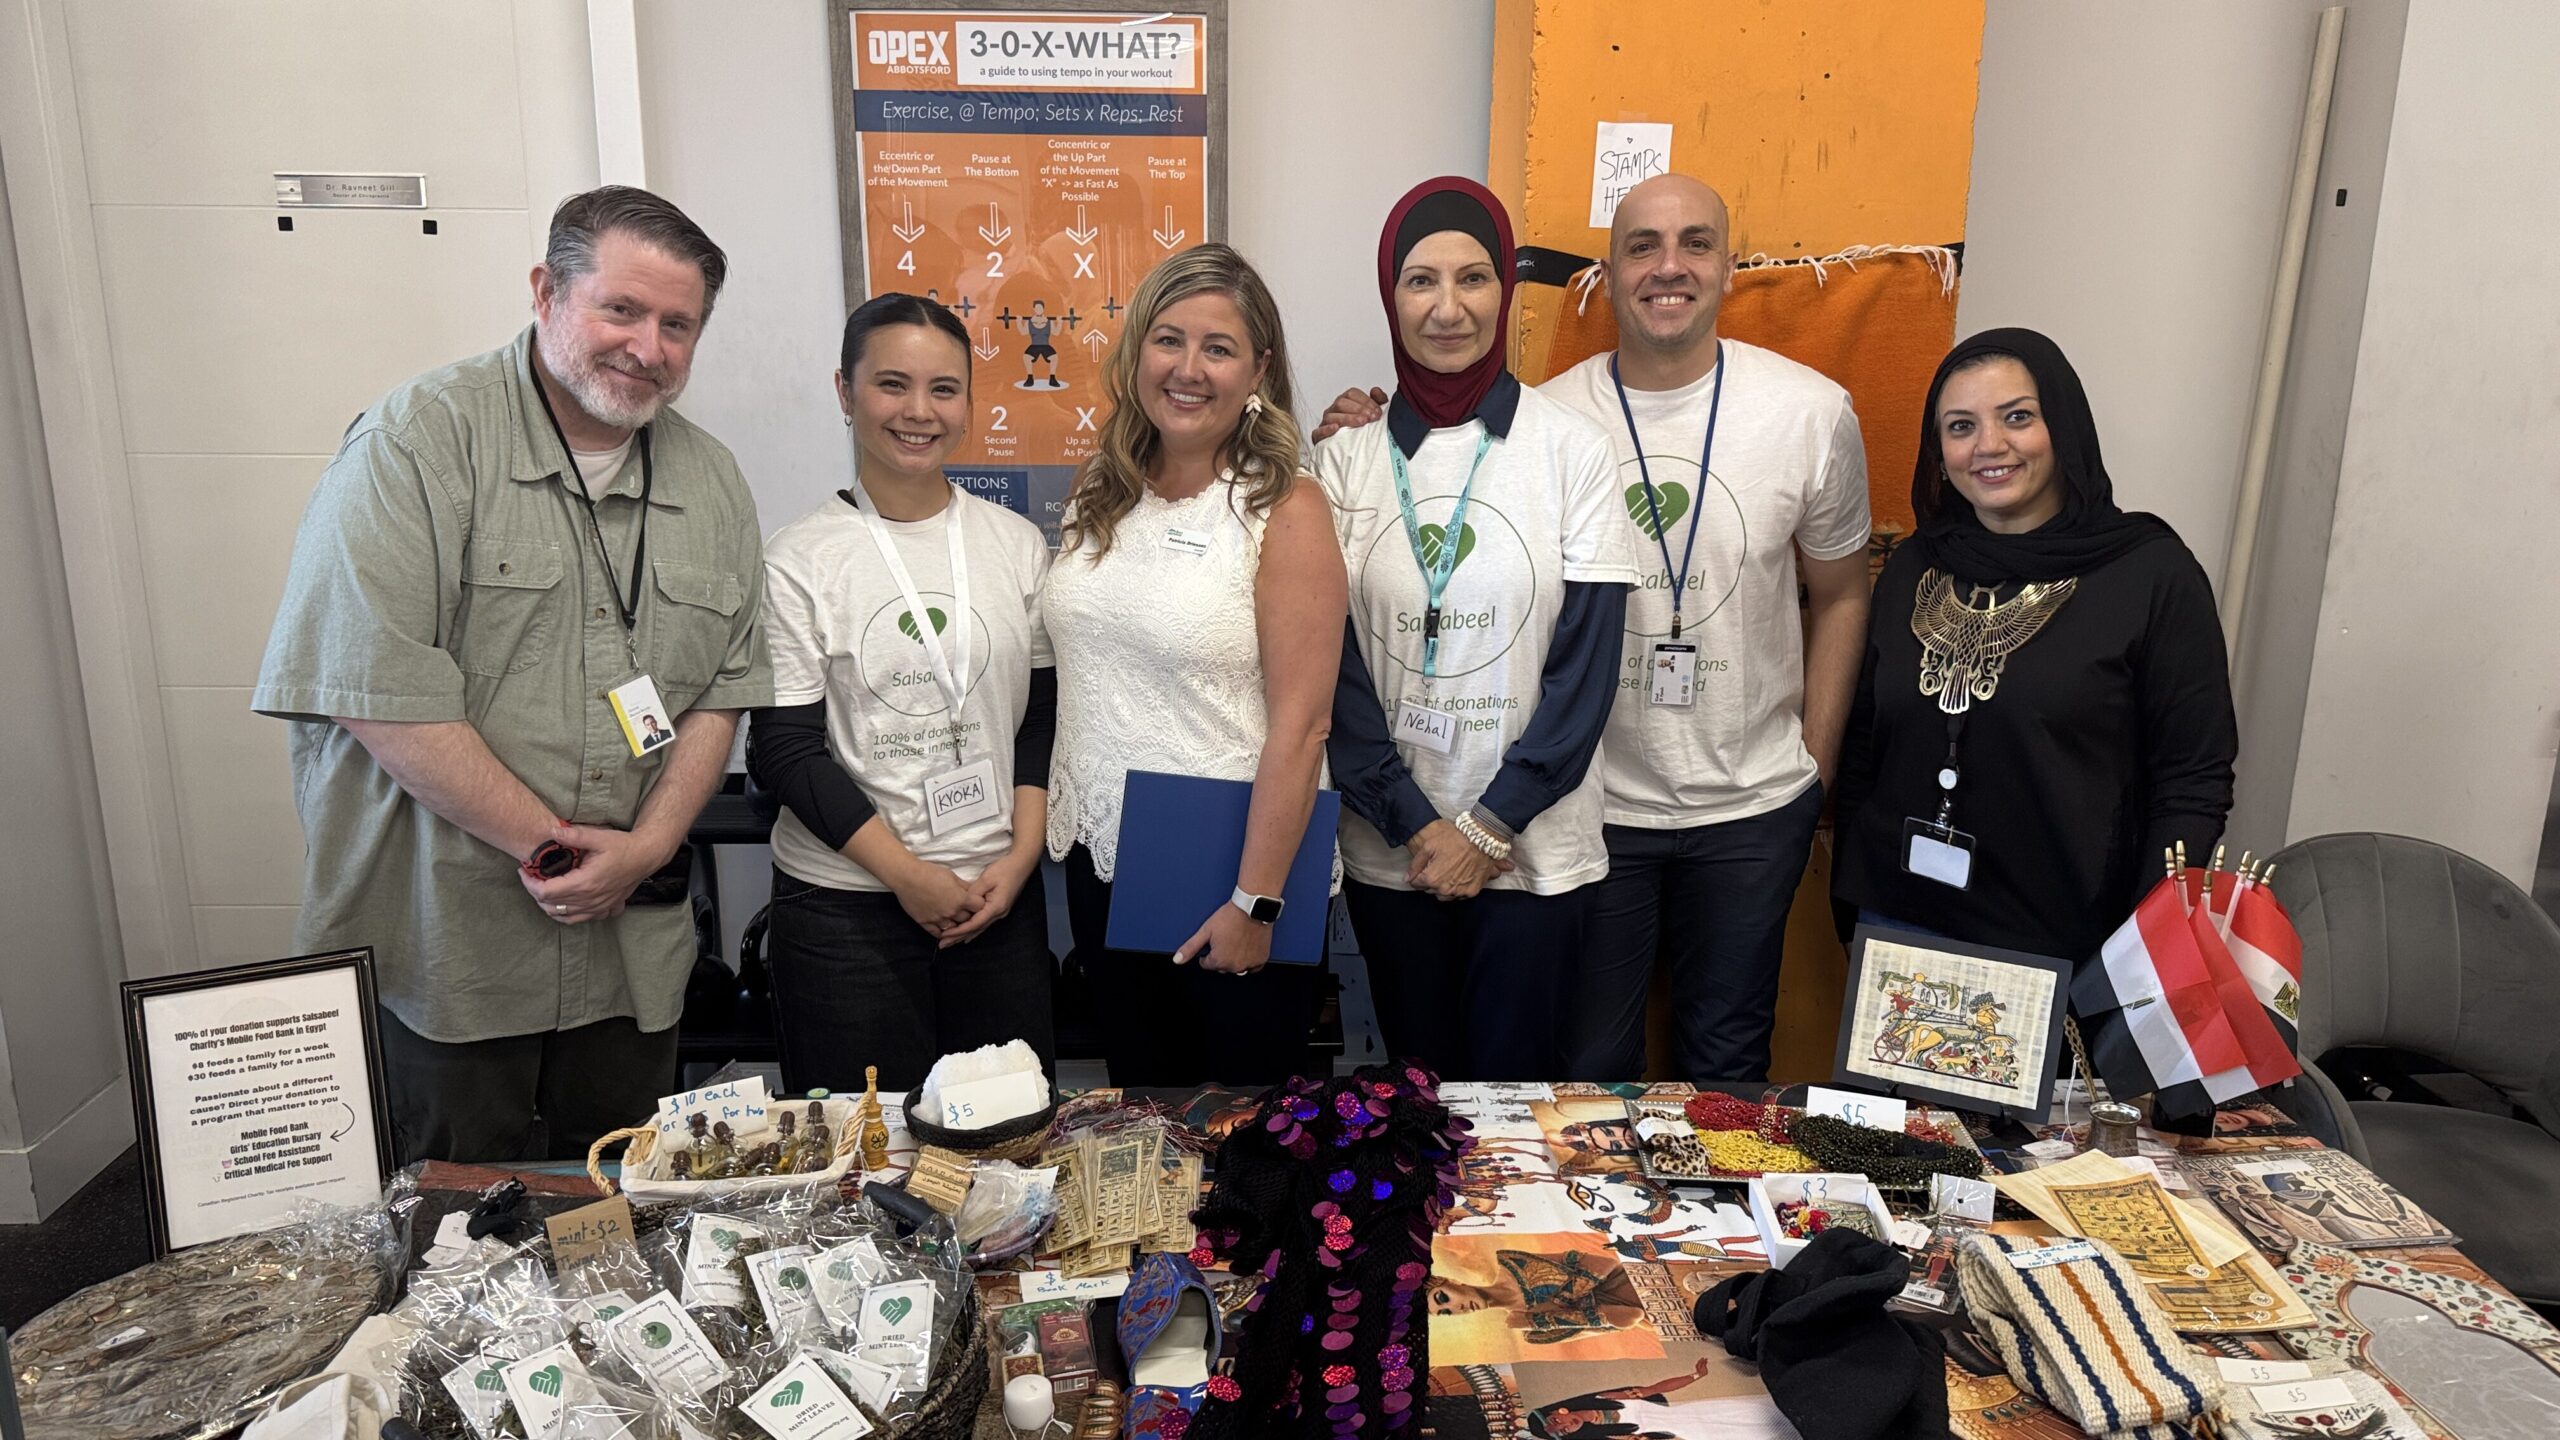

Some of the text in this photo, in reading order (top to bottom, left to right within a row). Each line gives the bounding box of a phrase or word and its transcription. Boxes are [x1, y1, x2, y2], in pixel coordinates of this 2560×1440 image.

[868, 30, 950, 65] OPEX
[970, 30, 1182, 60] 3-0-X-WHAT?
[887, 65, 951, 75] ABBOTSFORD
[988, 67, 1015, 78] guide
[1018, 68, 1029, 76] to
[1031, 67, 1057, 79] using
[1060, 68, 1092, 79] tempo
[1095, 67, 1104, 77] in
[1106, 69, 1128, 80] your
[1130, 67, 1173, 79] workout
[883, 101, 1184, 126] Exercise, @ Tempo; Sets x Reps; Rest
[1048, 139, 1111, 150] Concentric or
[879, 150, 935, 161] Eccentric or
[971, 154, 1011, 165] Pause at
[1053, 153, 1106, 165] the Up Part
[1148, 156, 1187, 167] Pause at
[1600, 148, 1664, 181] STAMPS
[873, 164, 942, 175] the Down Part
[964, 167, 1019, 177] The Bottom
[1040, 165, 1120, 177] of the Movement
[1148, 169, 1186, 181] The Top
[342, 183, 396, 192] Ravneet Gill
[868, 177, 948, 188] of the Movement
[1086, 179, 1105, 189] Fast
[1106, 180, 1119, 189] As
[1061, 191, 1100, 201] Possible
[897, 251, 916, 276] 4
[986, 252, 1004, 277] 2
[1073, 253, 1095, 279] X
[990, 406, 1008, 431] 2
[1075, 406, 1097, 432] X
[984, 436, 1017, 446] Second
[1065, 436, 1079, 446] Up
[988, 447, 1015, 457] Pause
[1063, 448, 1076, 457] As
[1627, 655, 1644, 672] of
[1404, 711, 1449, 739] Nehal
[873, 729, 926, 746] 100% of
[873, 749, 886, 761] to
[889, 740, 925, 757] those
[928, 742, 939, 754] in
[938, 783, 982, 811] KYOKA
[174, 1009, 339, 1042] 100% of your donation supports Salsabeel
[190, 1022, 327, 1051] Charity's Mobile Food Bank in Egypt
[206, 1056, 235, 1068] feeds
[245, 1050, 277, 1062] family
[278, 1047, 293, 1057] for
[303, 1042, 330, 1052] week
[208, 1067, 236, 1079] feeds
[247, 1060, 278, 1072] family
[280, 1057, 295, 1068] for
[305, 1051, 336, 1063] month
[195, 1087, 250, 1103] Passionate
[252, 1082, 281, 1094] about
[291, 1074, 334, 1088] different
[704, 1082, 740, 1101] each
[190, 1084, 340, 1115] cause? Direct your donation to
[200, 1112, 243, 1127] program
[245, 1108, 265, 1117] that
[267, 1101, 307, 1114] matters
[308, 1098, 319, 1107] to
[320, 1096, 339, 1107] you
[663, 1104, 765, 1132] or for two
[948, 1102, 975, 1127] $5
[1842, 1102, 1867, 1129] $5
[241, 1121, 309, 1141] Mobile Food Bank
[230, 1131, 322, 1155] Girls' Education Bursary
[234, 1143, 321, 1166] School Fee Assistance
[224, 1153, 333, 1180] Critical Medical Fee Support
[1802, 1177, 1827, 1200] $3
[868, 1342, 888, 1350] MINT
[881, 1333, 905, 1342] DRIED
[651, 1353, 672, 1369] DRIED
[671, 1343, 690, 1356] MINT
[2250, 1366, 2271, 1380] $5
[2287, 1387, 2308, 1403] $5
[788, 1418, 809, 1433] MINT
[808, 1401, 836, 1420] LEAVES
[795, 1402, 819, 1420] DRIED
